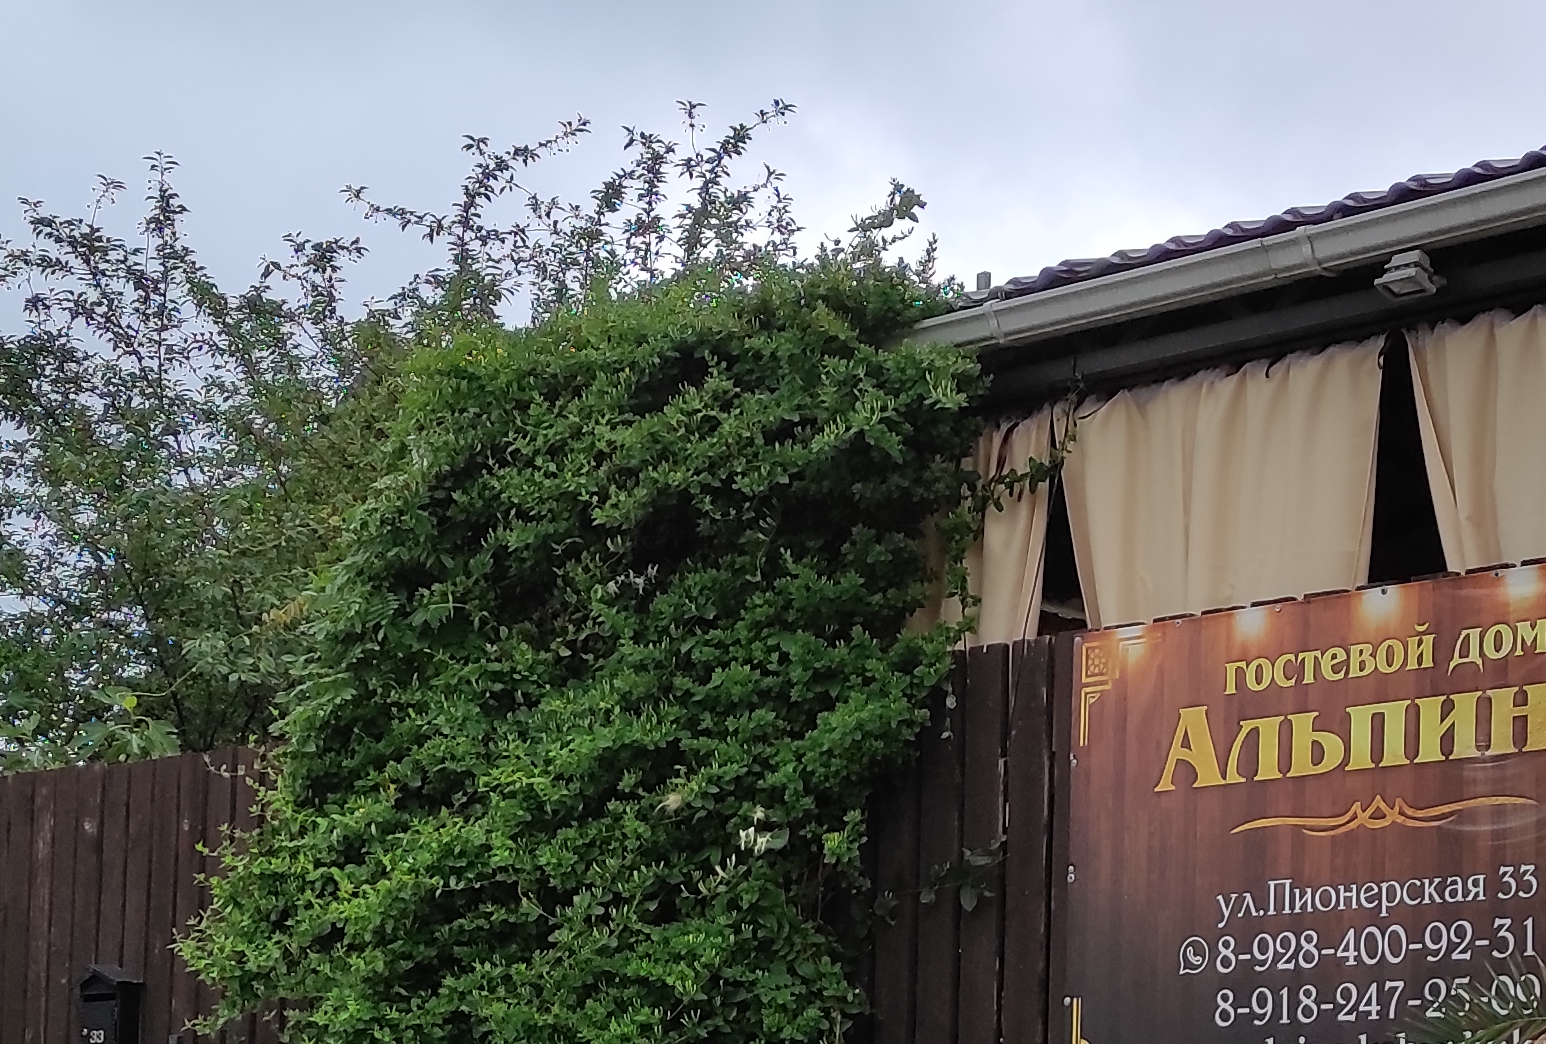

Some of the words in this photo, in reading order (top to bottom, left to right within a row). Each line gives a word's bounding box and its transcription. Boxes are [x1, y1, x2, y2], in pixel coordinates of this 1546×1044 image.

[1224, 622, 1437, 695] гостевой
[1497, 864, 1539, 899] 33
[1215, 917, 1537, 974] 8-928-400-92-31
[1214, 973, 1542, 1028] 8-918-247-25-09
